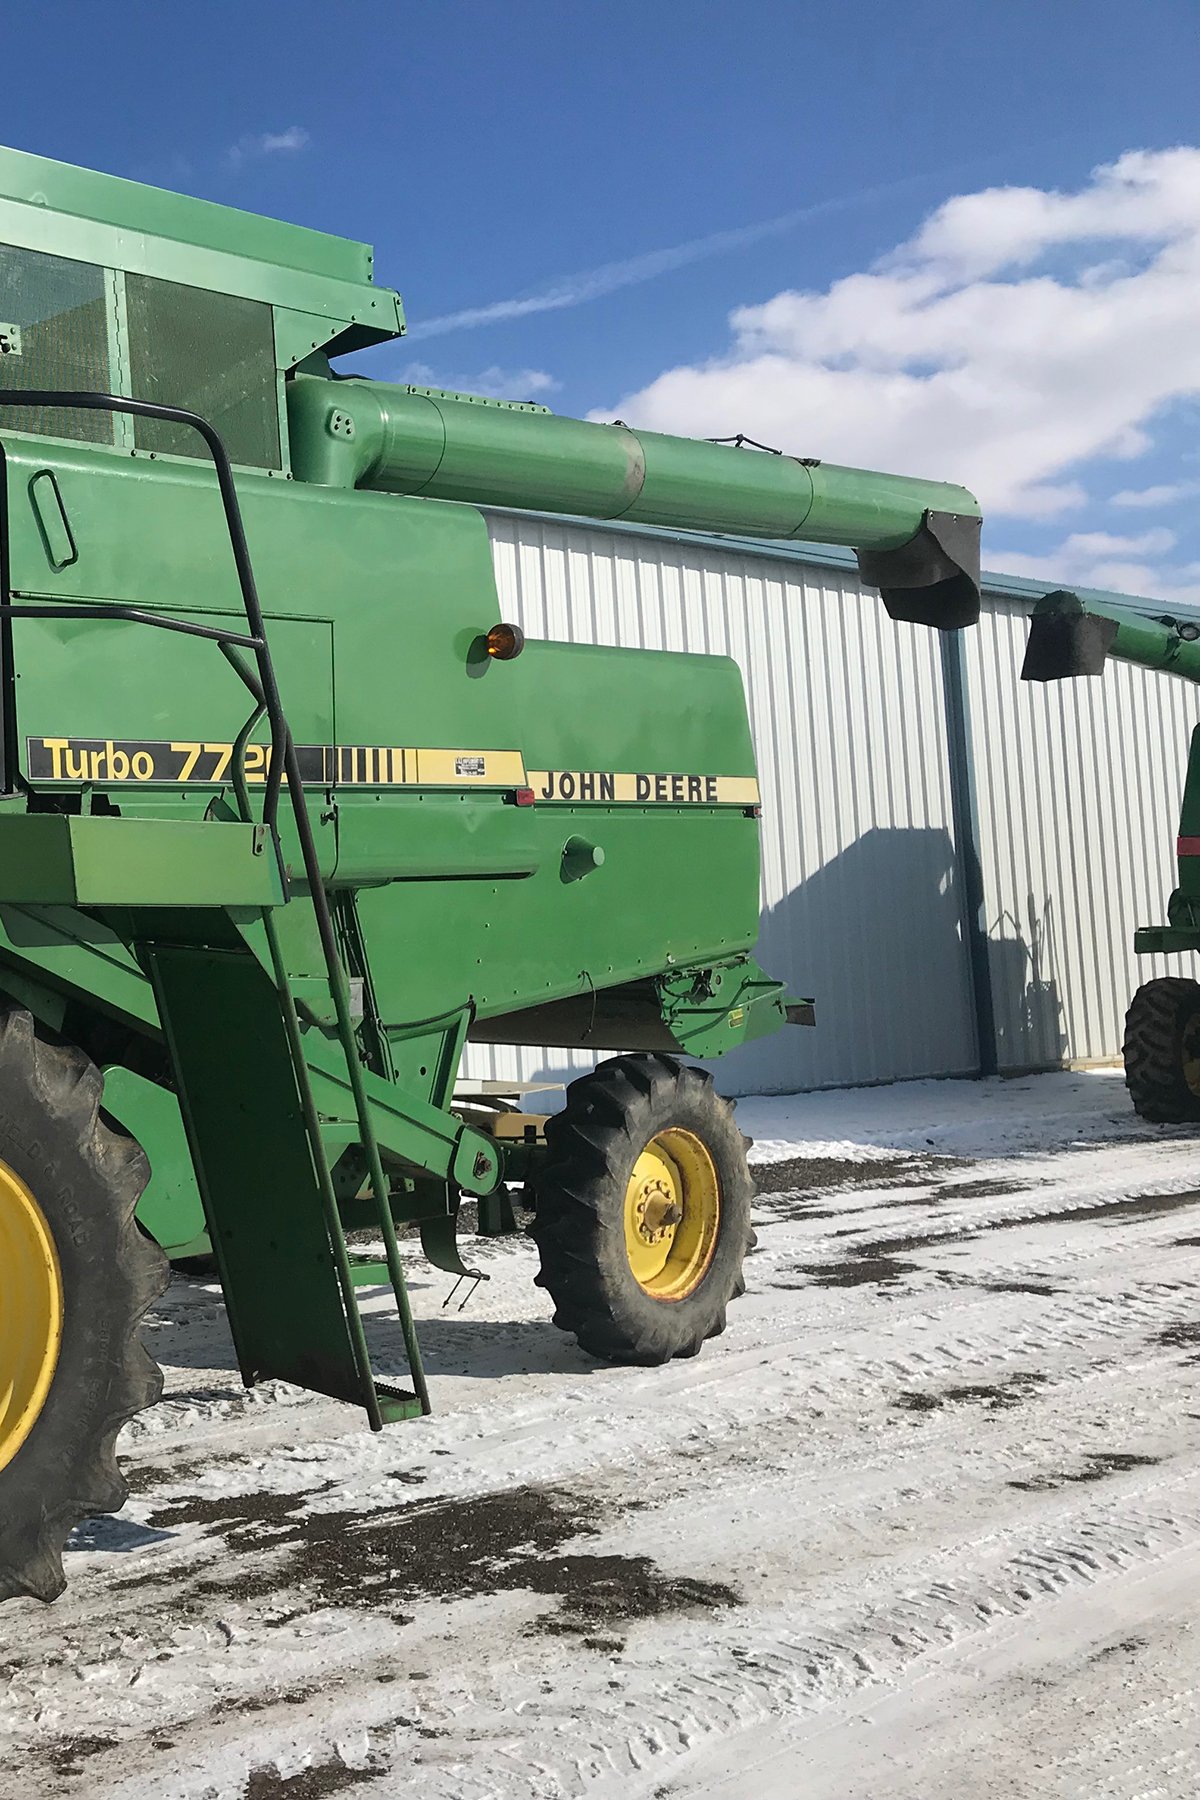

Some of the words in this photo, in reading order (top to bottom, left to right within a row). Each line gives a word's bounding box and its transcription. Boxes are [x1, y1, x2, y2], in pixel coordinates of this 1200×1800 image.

[43, 738, 155, 780] Turbo
[542, 771, 614, 800] JOHN
[636, 774, 718, 802] DEERE
